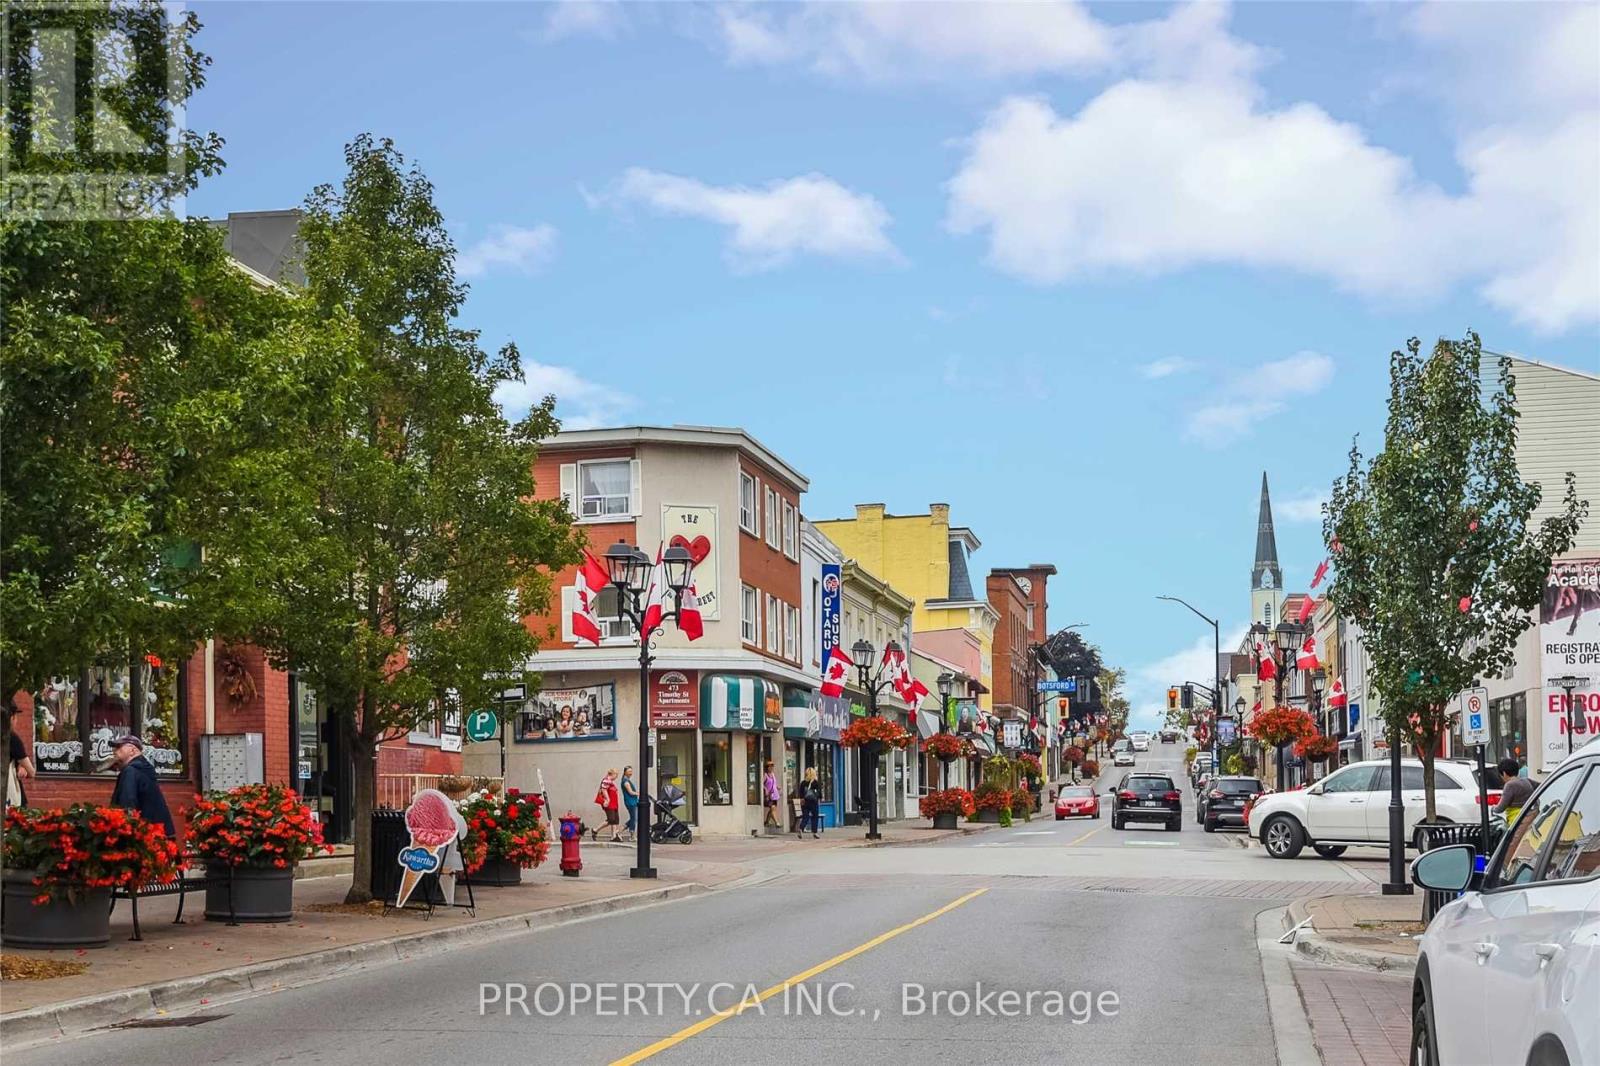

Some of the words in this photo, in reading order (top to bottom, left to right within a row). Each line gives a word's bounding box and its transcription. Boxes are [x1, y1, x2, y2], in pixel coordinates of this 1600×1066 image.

[681, 513, 699, 524] THE
[1547, 572, 1600, 587] Acade
[823, 597, 832, 650] OTARU
[1546, 642, 1600, 654] REGISTRA
[1565, 654, 1576, 665] IS
[1037, 681, 1070, 690] BOTSFORD
